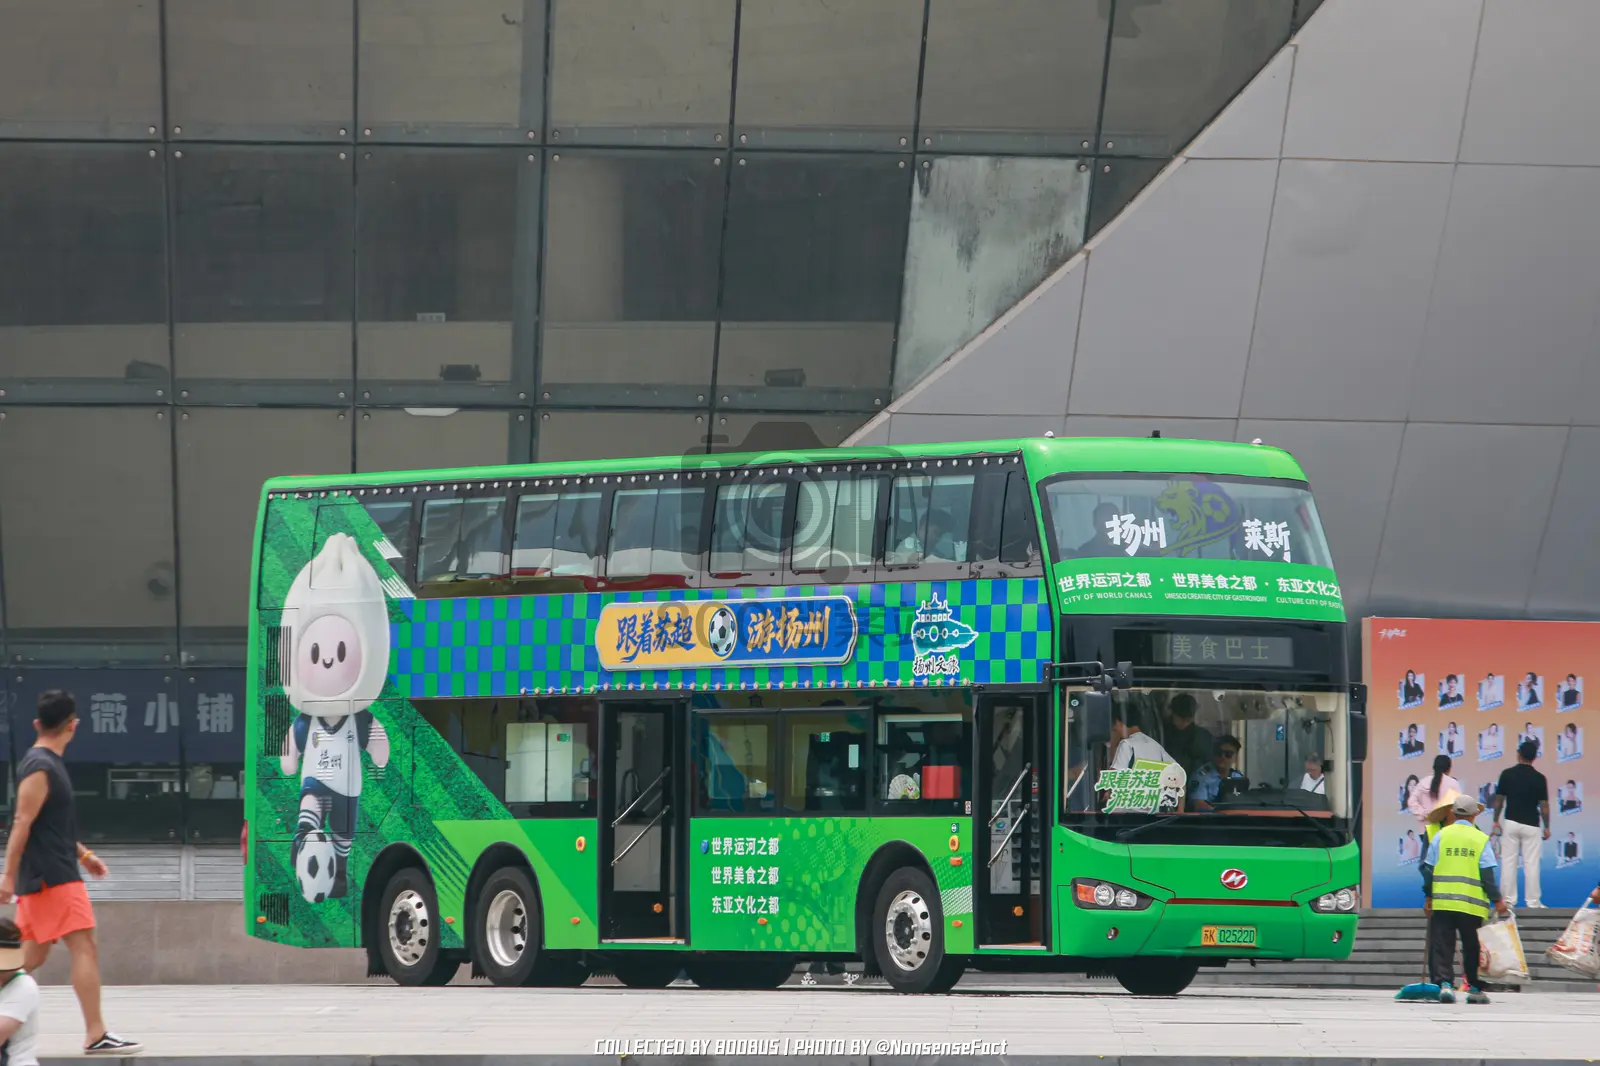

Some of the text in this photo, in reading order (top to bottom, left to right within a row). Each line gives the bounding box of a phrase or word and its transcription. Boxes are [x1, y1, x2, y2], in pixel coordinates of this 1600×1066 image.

[1105, 513, 1291, 563] 扬州 莱斯
[1058, 572, 1342, 600] 世界运河之都 世界美食之都 东亚文化之
[1063, 594, 1081, 605] CITY
[1084, 592, 1095, 601] OF
[1125, 591, 1153, 599] CANALS
[1164, 592, 1187, 600] UNESCO
[1188, 593, 1212, 601] CREATIVE
[1275, 596, 1305, 605] CULTURE
[1319, 599, 1327, 607] OF
[615, 605, 830, 663] 跟着苏超 游扬州
[1173, 635, 1269, 661] 美食巴士
[1096, 770, 1161, 789] 跟着苏超
[1102, 788, 1161, 814] 游扬州
[711, 837, 779, 856] 世界运河之都
[711, 866, 779, 885] 世界美食之都
[711, 895, 779, 914] 东亚文化之都
